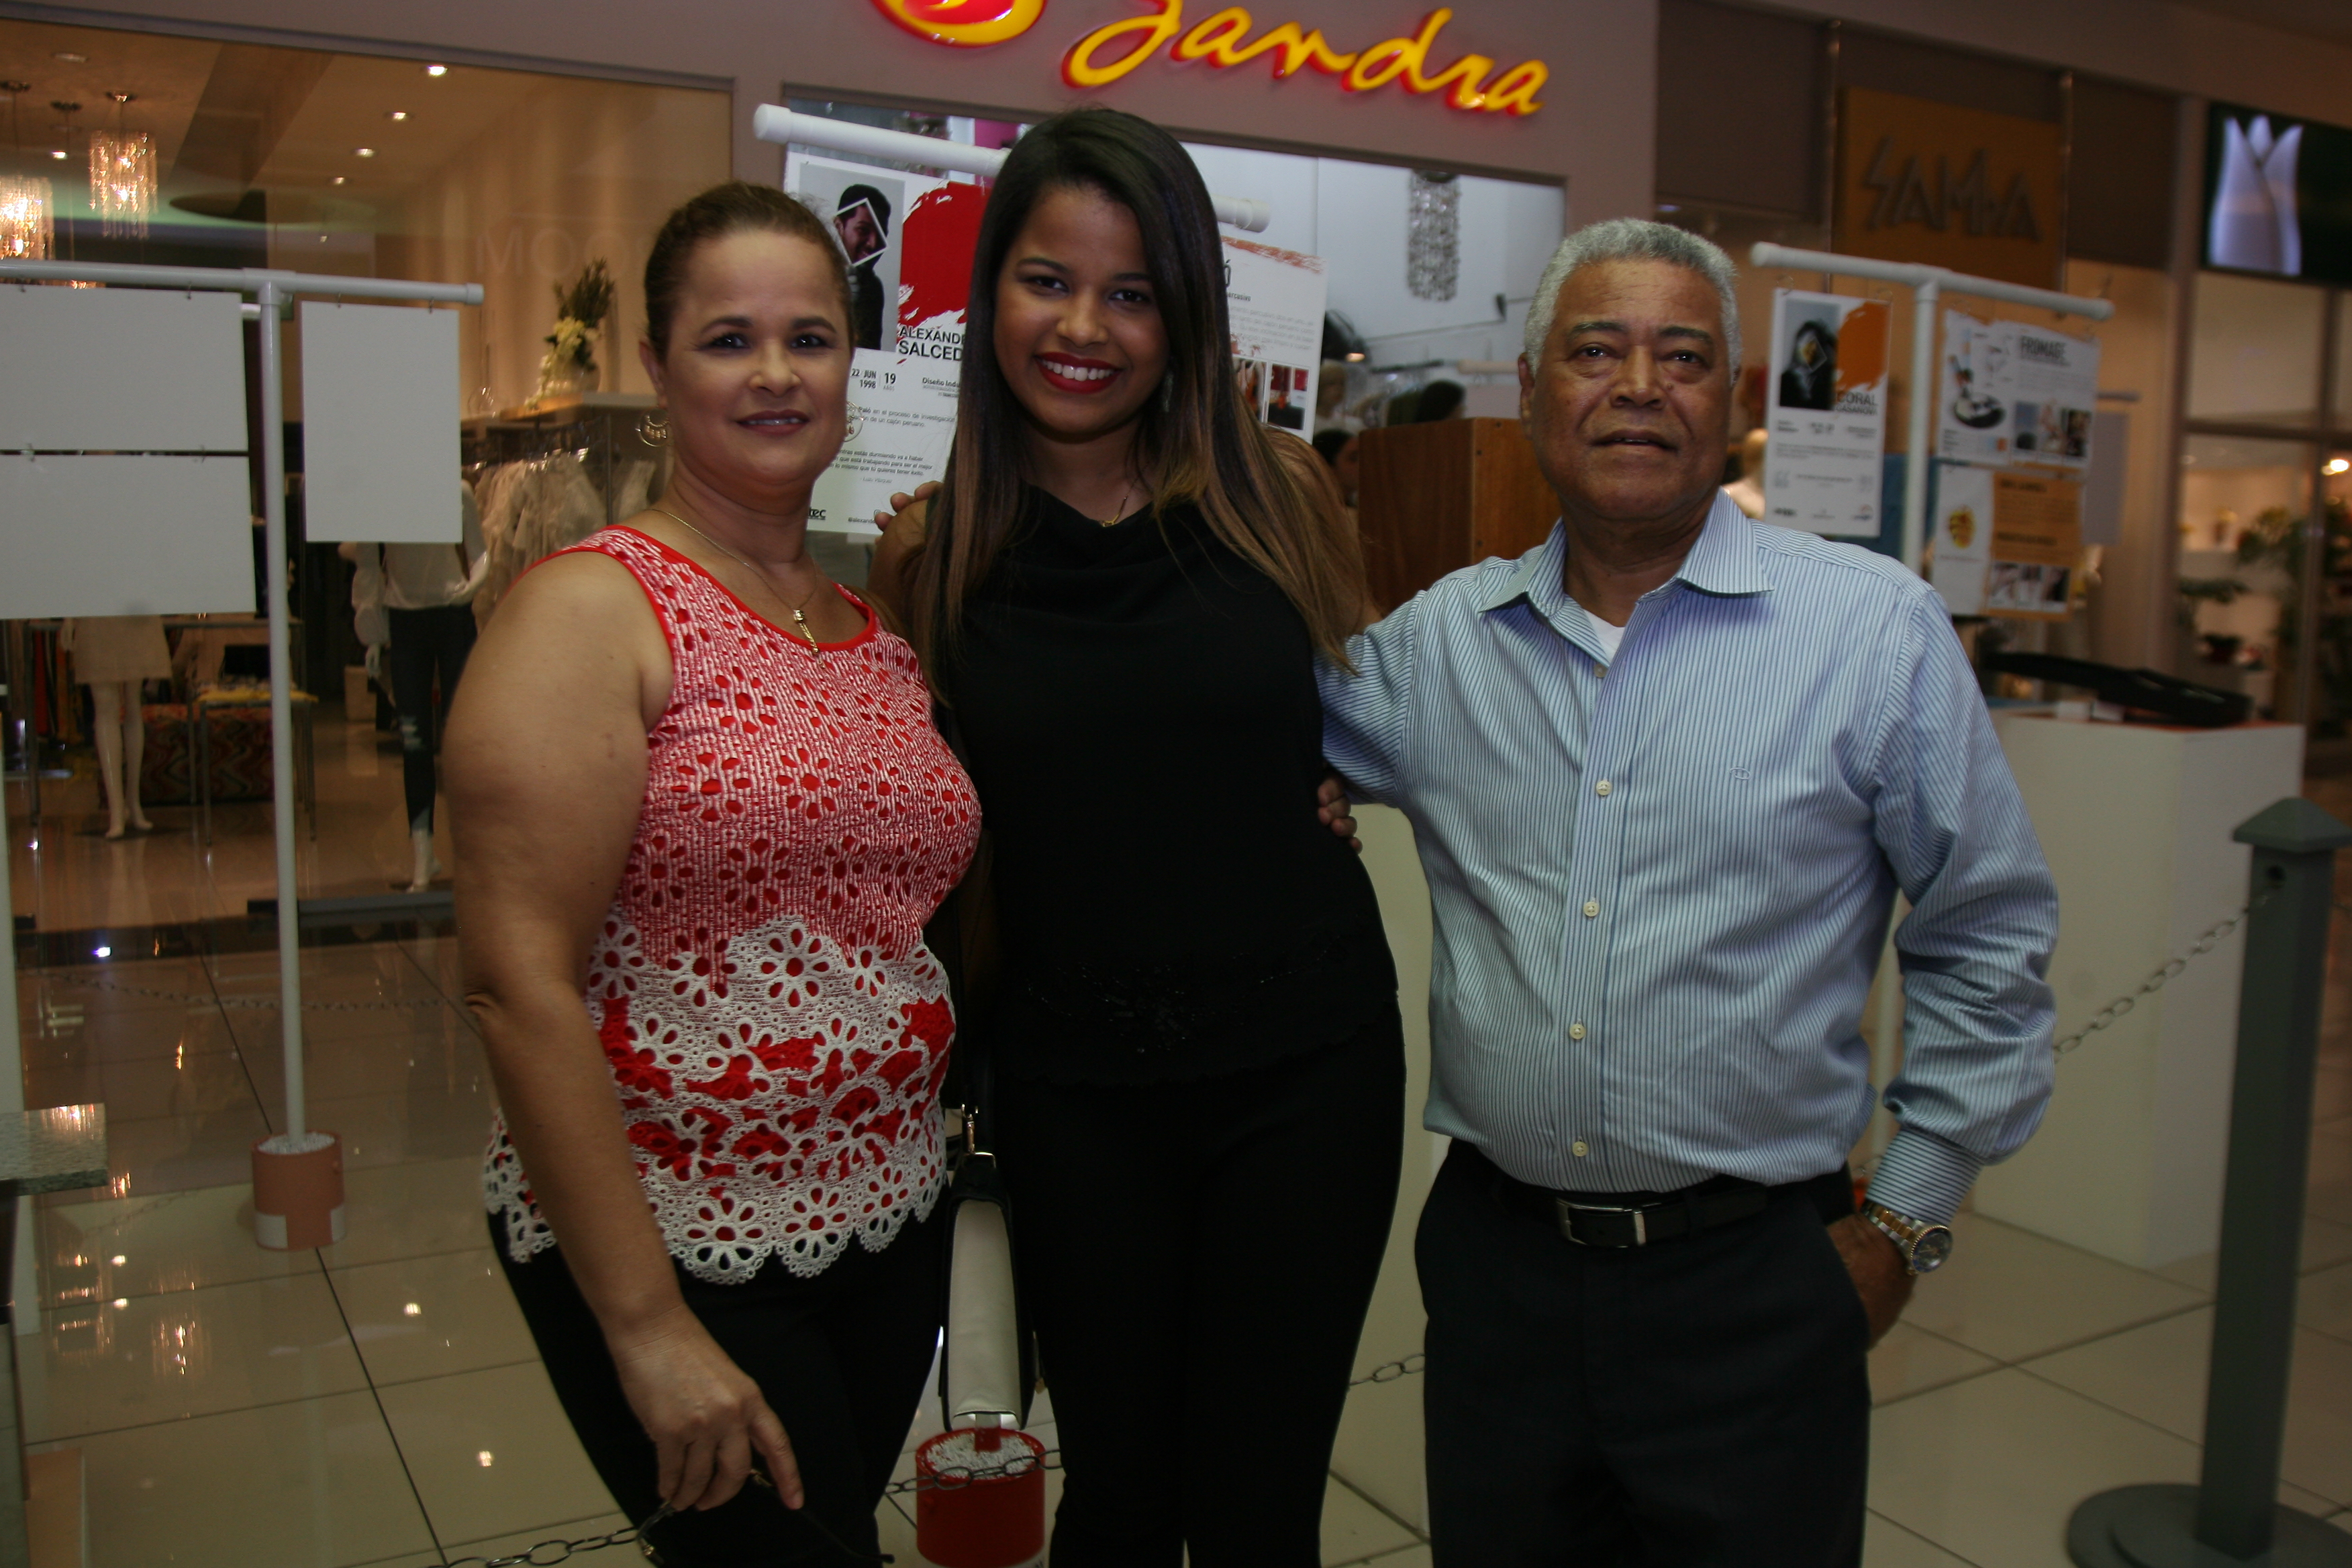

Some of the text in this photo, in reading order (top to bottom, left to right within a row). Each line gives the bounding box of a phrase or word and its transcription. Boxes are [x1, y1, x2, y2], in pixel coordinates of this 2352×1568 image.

[1227, 292, 1251, 301] ercusivo
[899, 341, 963, 361] SALCED
[852, 368, 877, 379] 22 JUN
[884, 373, 896, 385] 19
[859, 379, 877, 389] 1998
[922, 377, 944, 386] Diseño
[809, 506, 827, 518] tec
